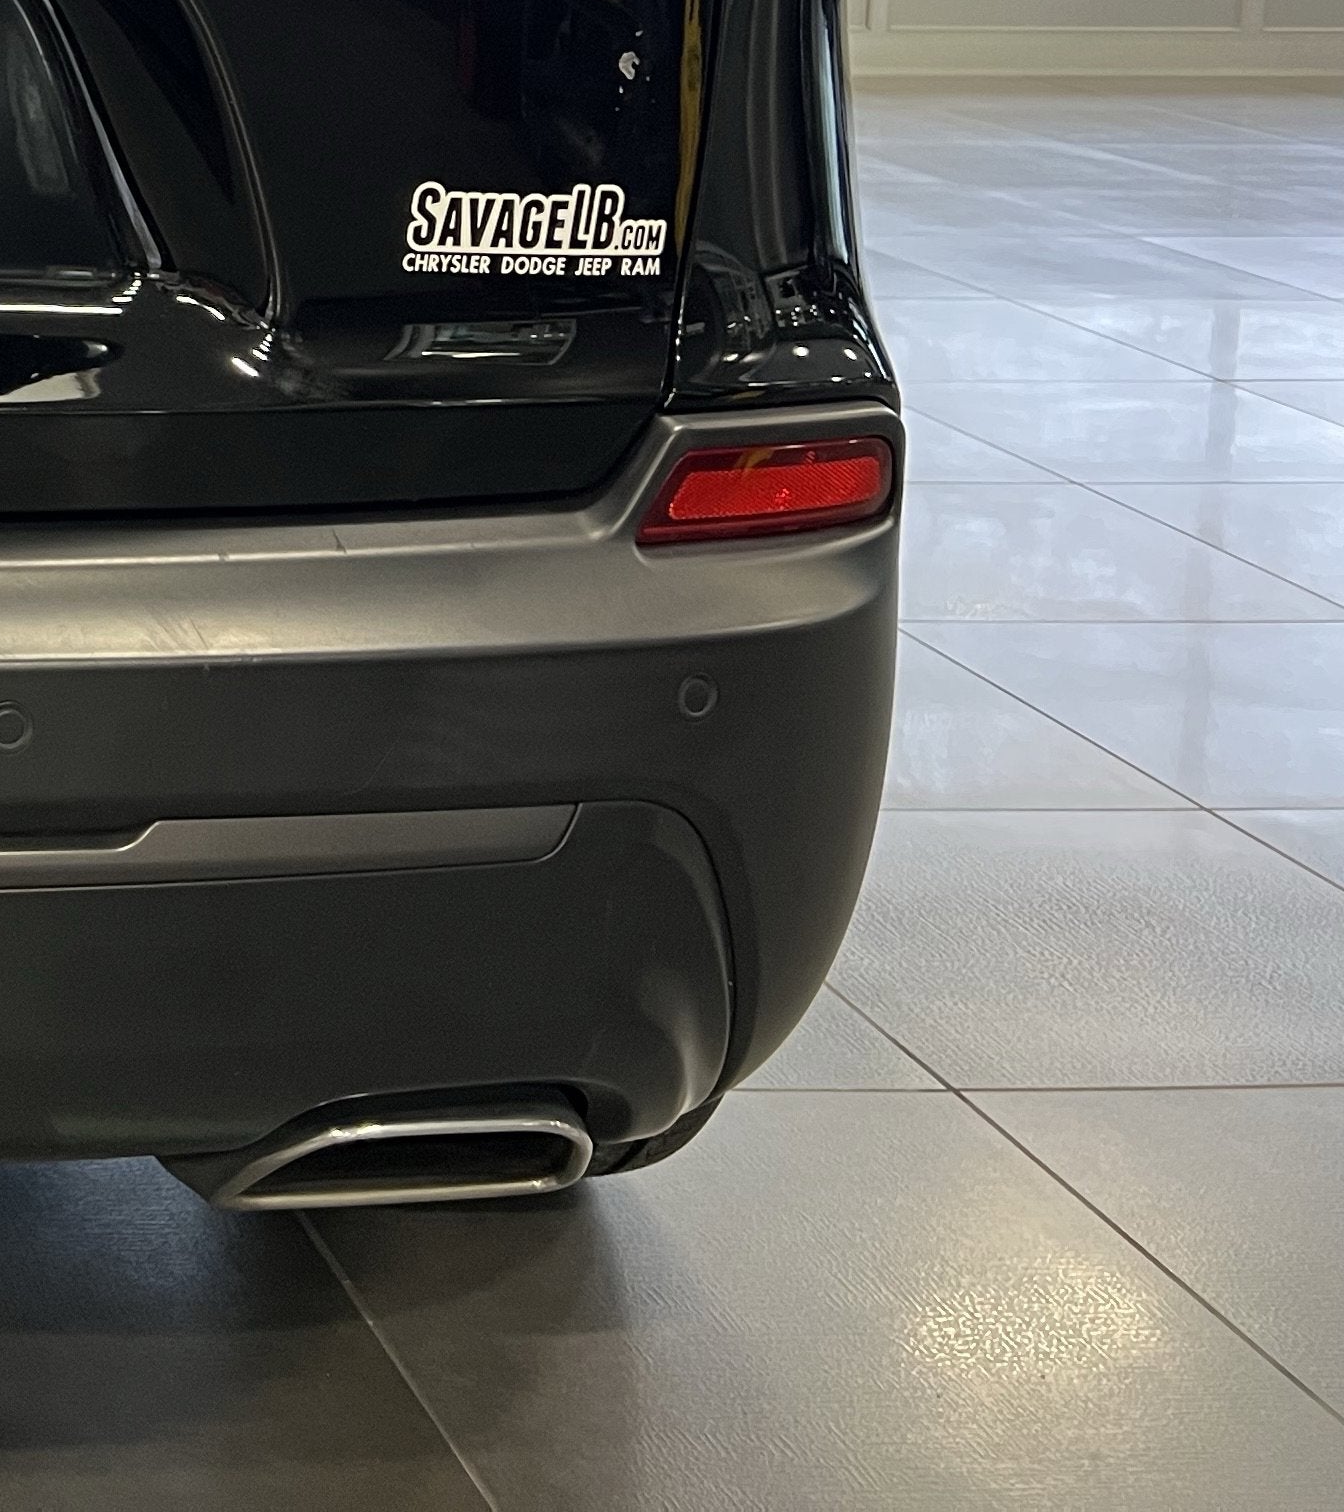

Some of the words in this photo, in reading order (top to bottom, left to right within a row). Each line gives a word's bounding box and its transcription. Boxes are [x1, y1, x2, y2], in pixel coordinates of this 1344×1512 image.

[401, 253, 491, 274] CHRYSLER
[500, 255, 567, 276] DODGE
[574, 257, 613, 276] JEEP
[620, 257, 661, 276] RAM
